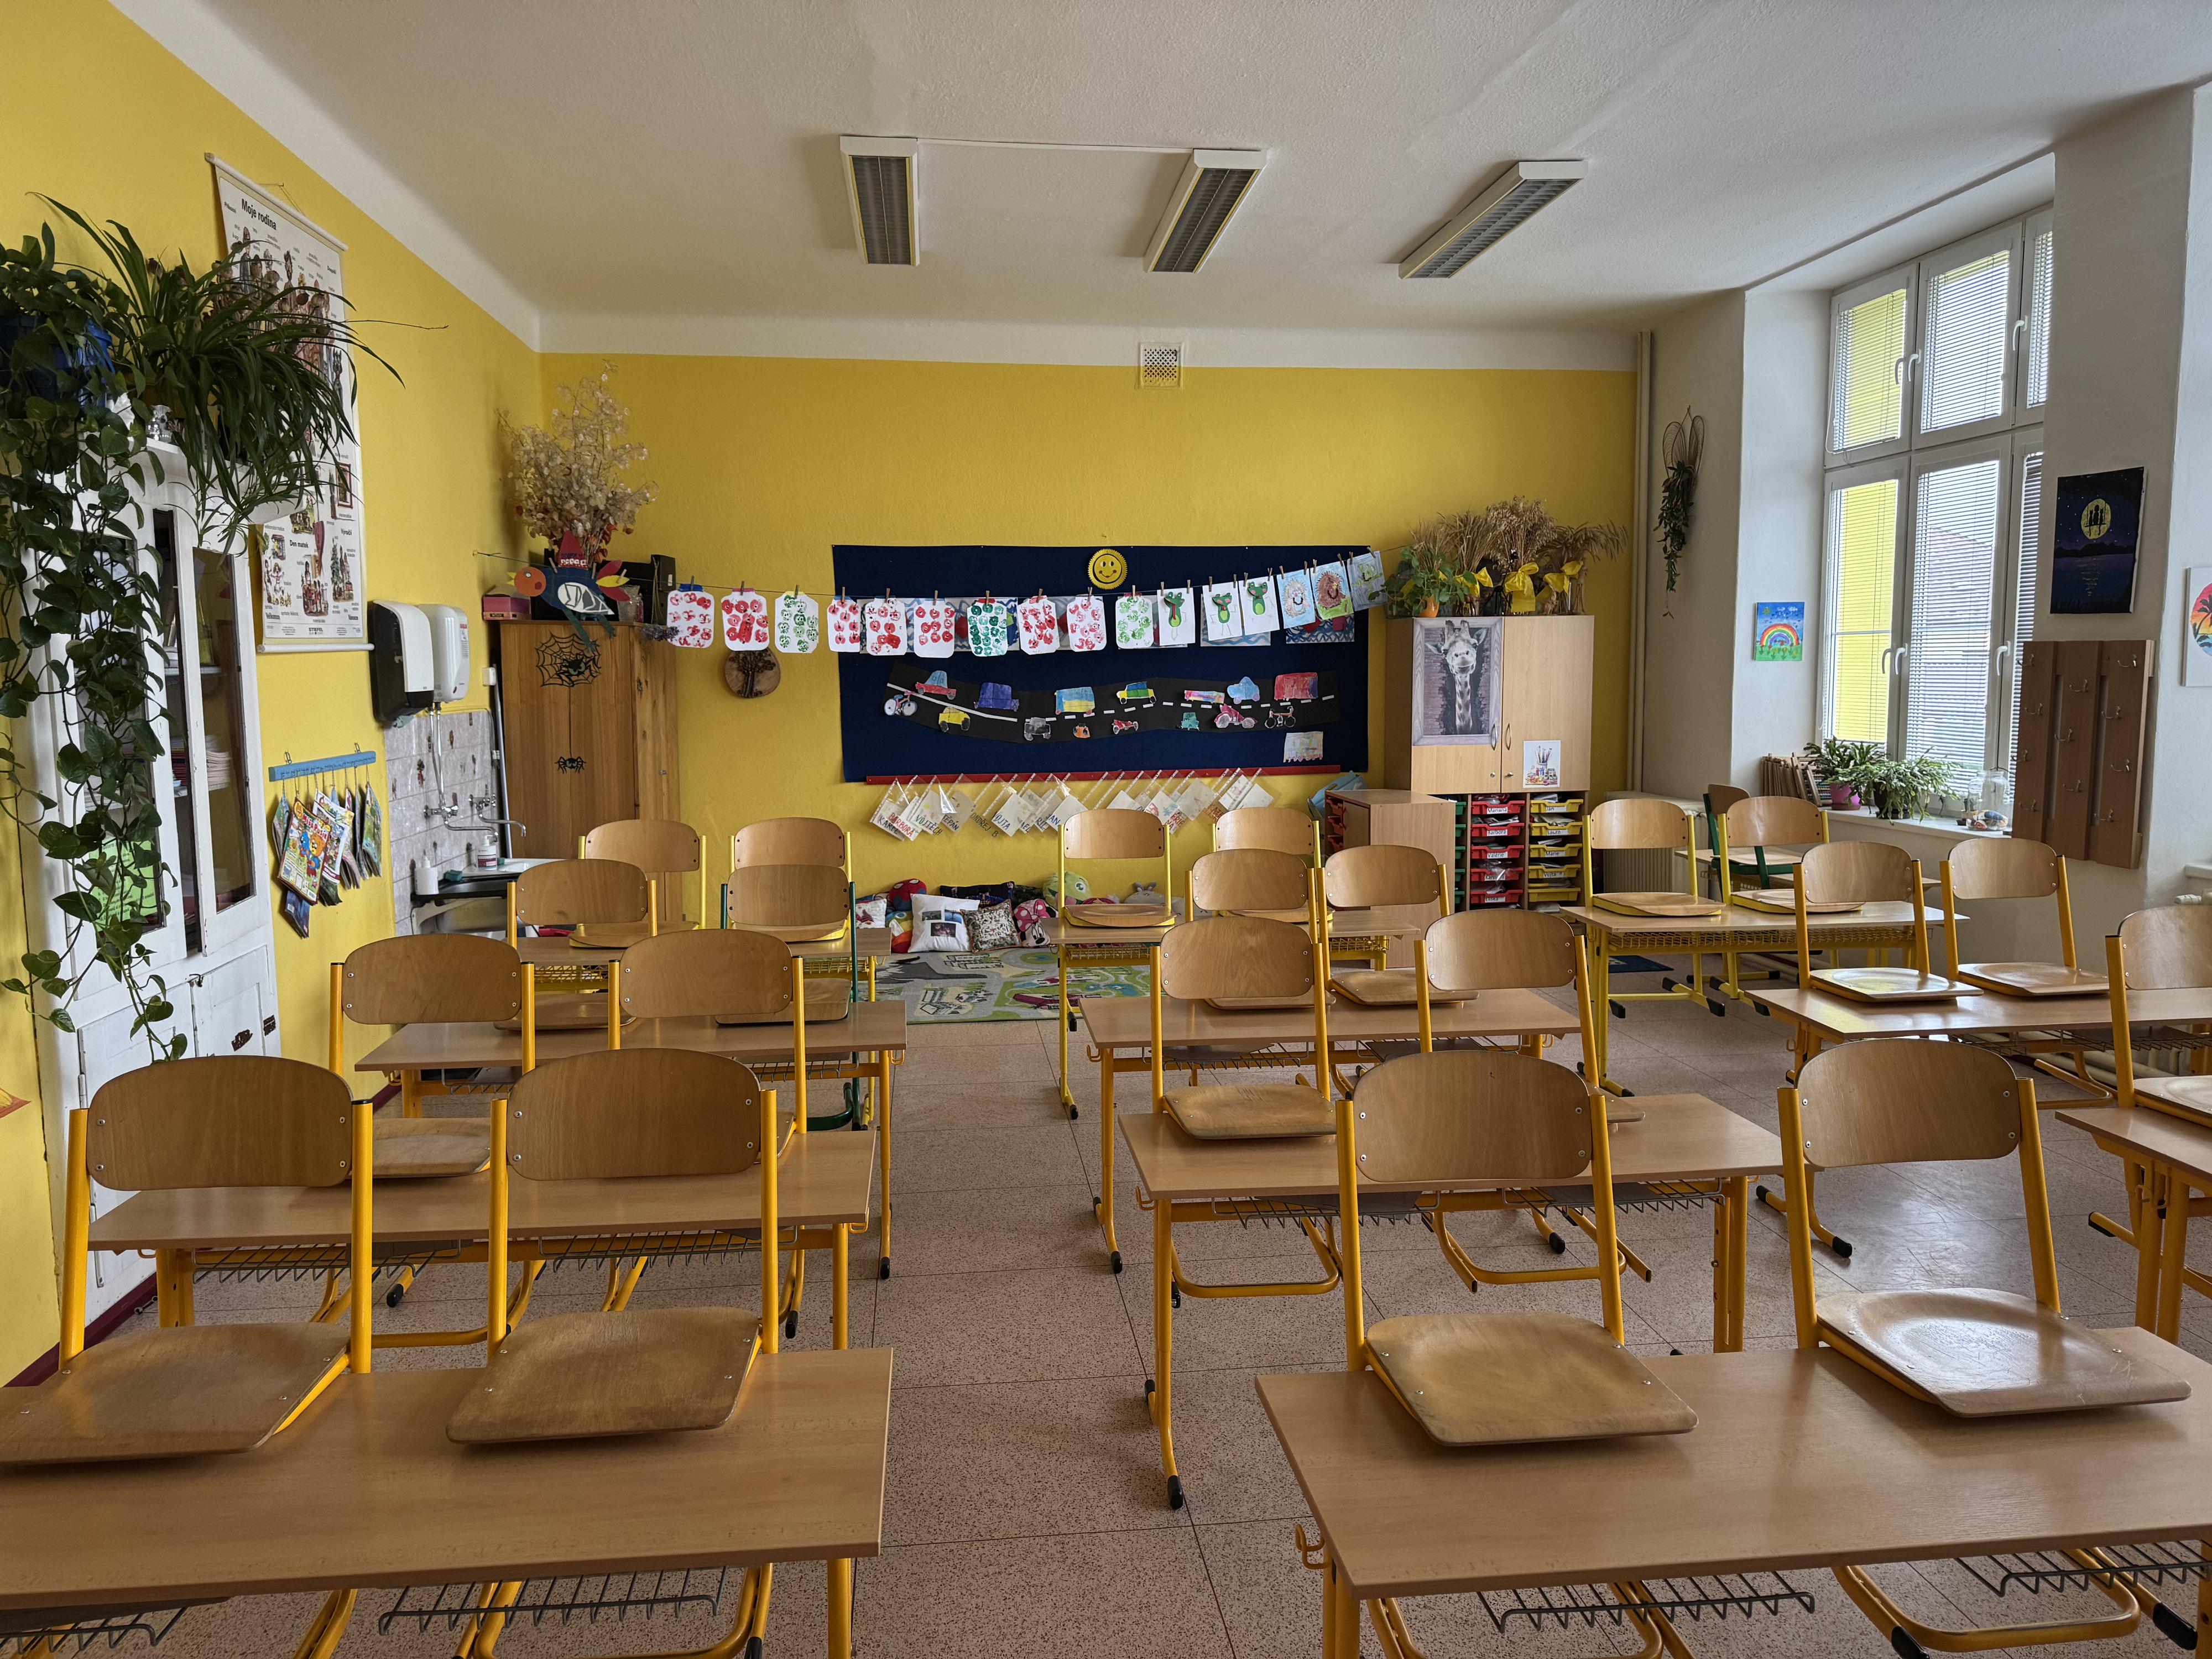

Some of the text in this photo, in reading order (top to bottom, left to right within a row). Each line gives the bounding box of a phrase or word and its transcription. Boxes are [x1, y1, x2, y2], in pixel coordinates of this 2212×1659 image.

[242, 198, 256, 218] Moje
[258, 212, 276, 230] rodina
[889, 812, 916, 837] BARBORA
[916, 814, 943, 836] VOJTĚCH
[941, 814, 959, 831] TĚPÁN
[970, 812, 991, 831] ONDŘEJ
